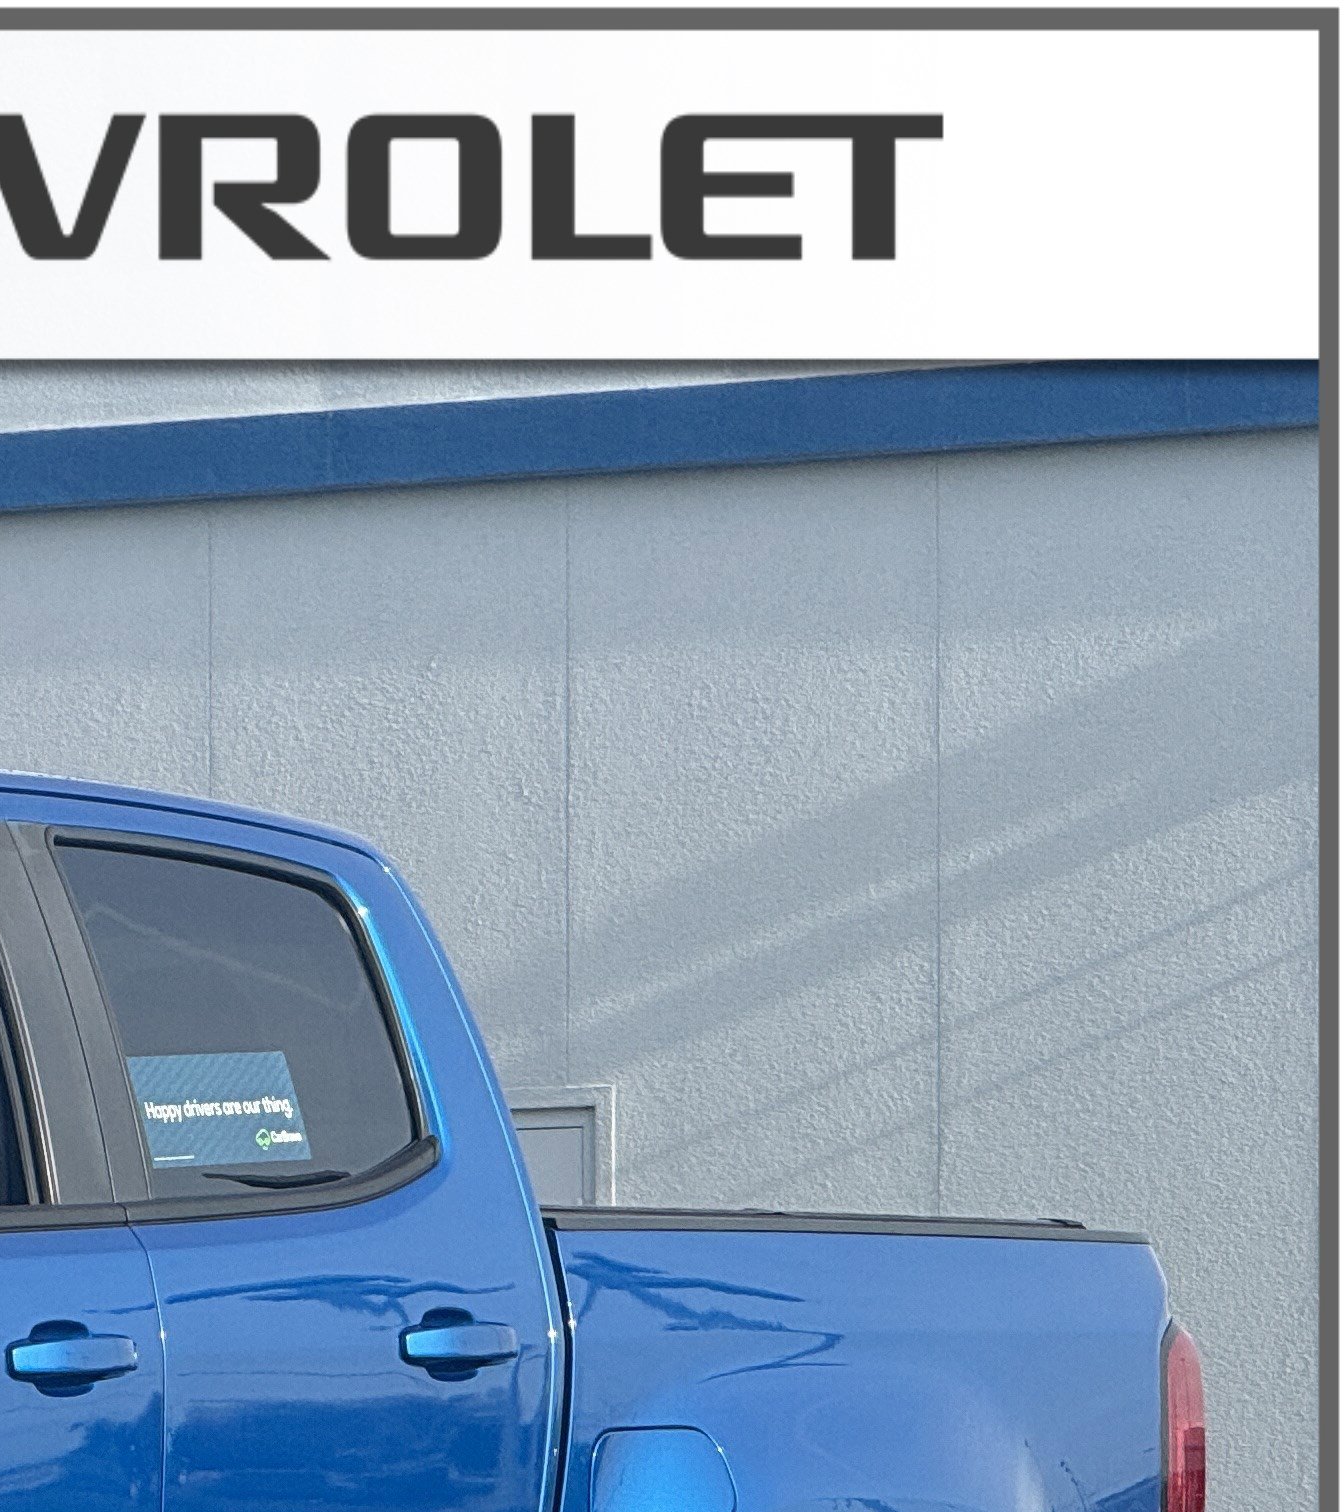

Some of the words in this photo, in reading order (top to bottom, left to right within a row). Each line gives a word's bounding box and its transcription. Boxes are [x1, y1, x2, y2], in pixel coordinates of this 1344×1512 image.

[143, 1101, 183, 1123] Happy
[183, 1098, 223, 1119] drivers
[223, 1102, 243, 1117] are
[242, 1100, 262, 1115] our
